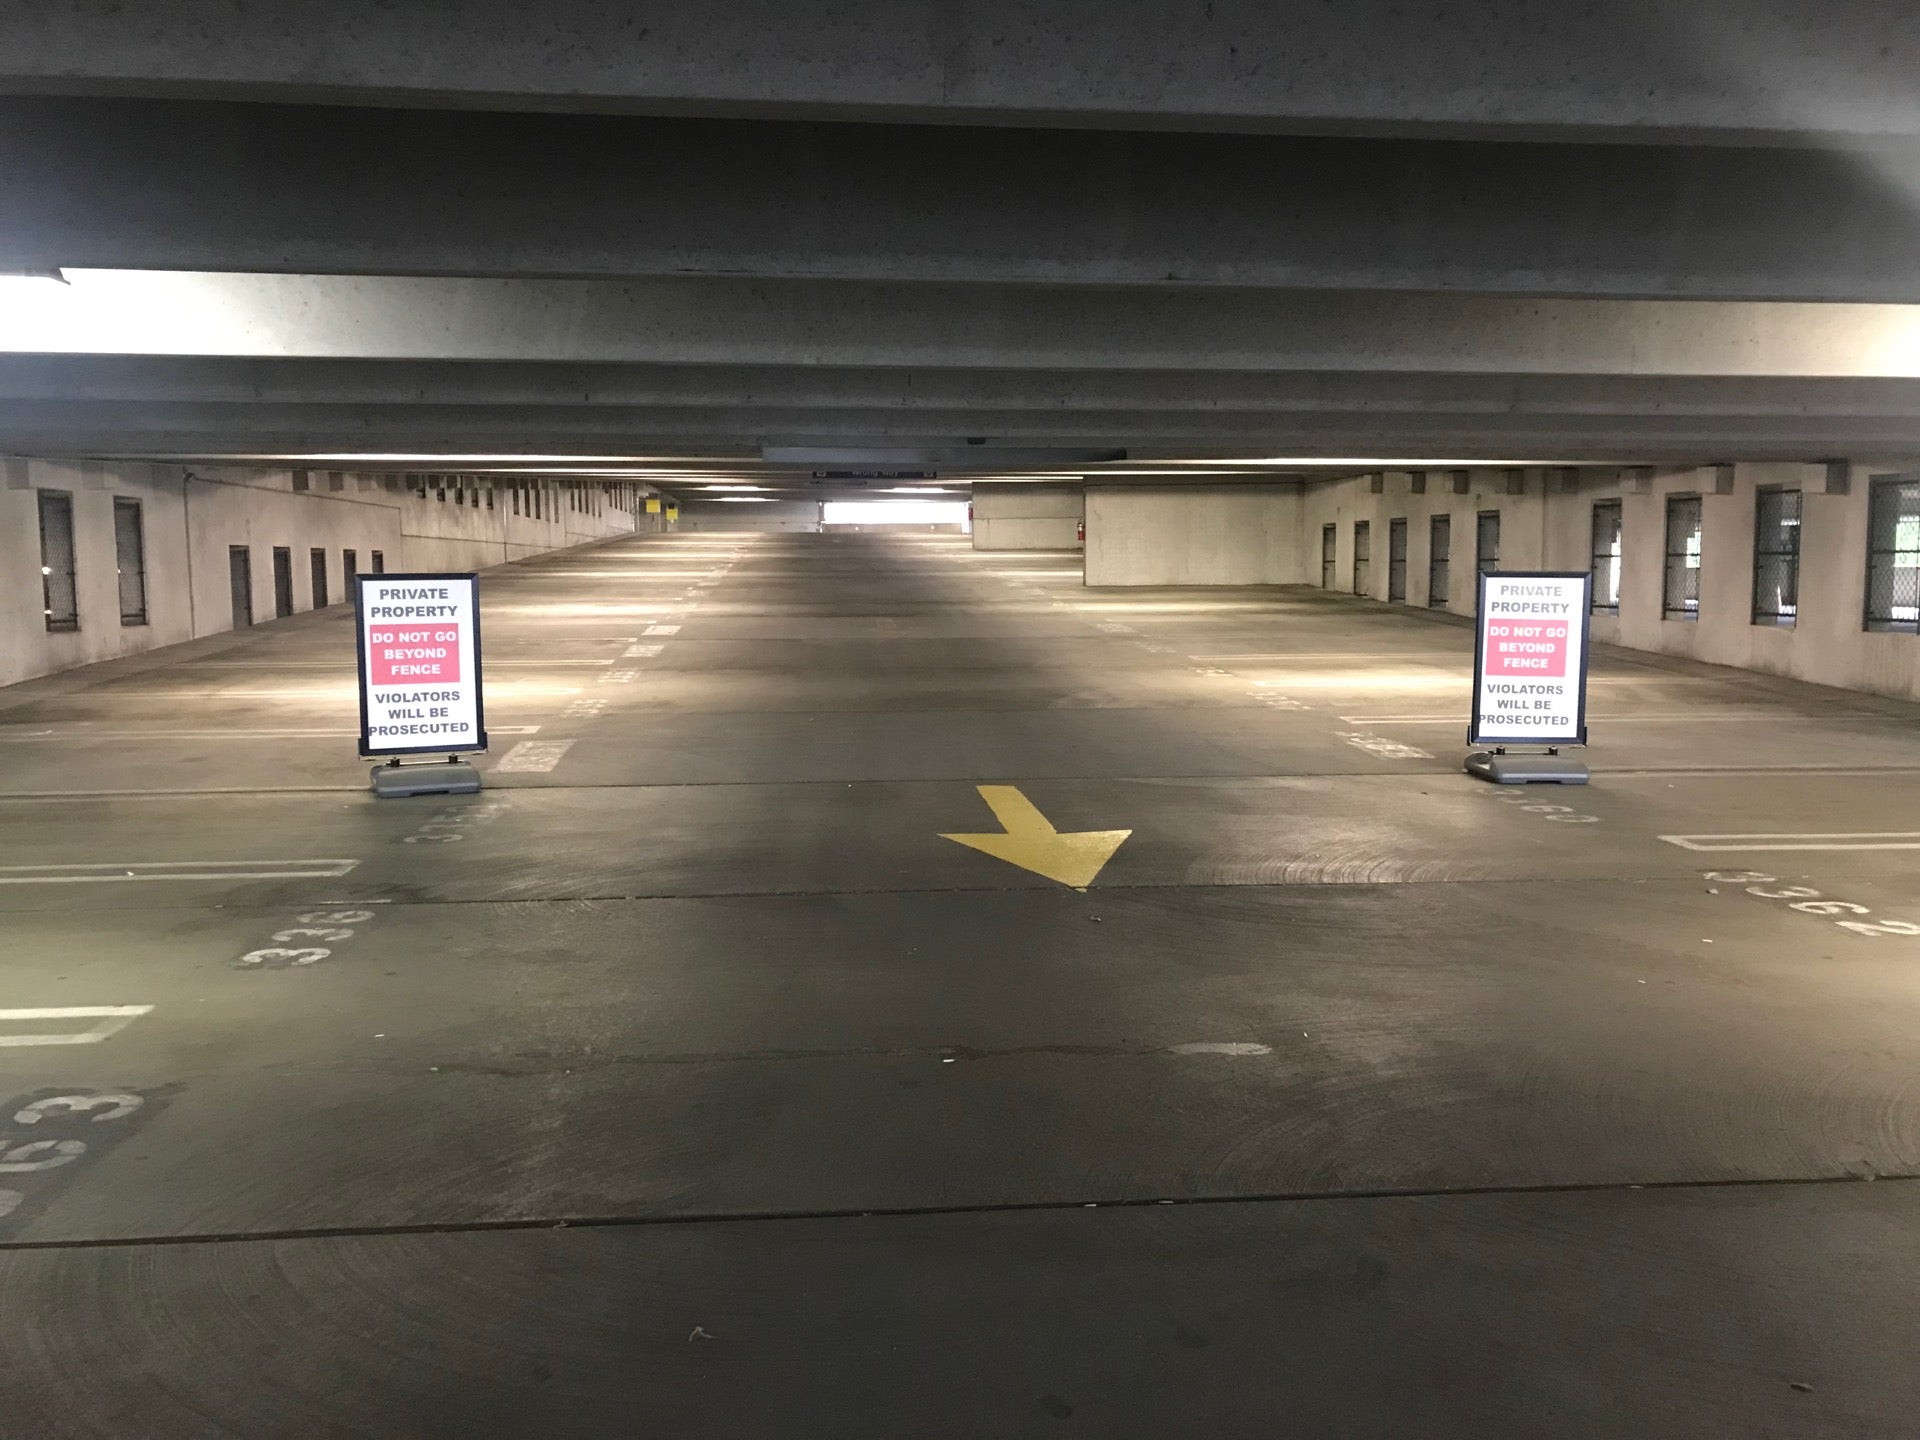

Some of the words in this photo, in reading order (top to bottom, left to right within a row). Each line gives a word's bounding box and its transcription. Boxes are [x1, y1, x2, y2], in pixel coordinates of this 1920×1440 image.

[379, 588, 449, 600] PRIVATE
[1500, 585, 1562, 597] PRIVATE
[371, 605, 458, 618] PROPERTY
[1491, 602, 1570, 614] PROPERTY
[372, 632, 394, 643] DO
[399, 631, 430, 643] NOT
[435, 631, 456, 642] GO
[1490, 626, 1509, 637] DO
[1513, 626, 1542, 638] NOT
[1546, 627, 1566, 638] GO
[384, 648, 446, 660] BEYOND
[1499, 643, 1555, 654] BEYOND
[1504, 658, 1548, 669] FENCE
[391, 664, 441, 676] FENCE
[1487, 684, 1564, 695] VIOLATORS
[375, 690, 460, 704] VIOLATORS
[1497, 700, 1529, 710] WILL
[1534, 700, 1552, 710] BE
[388, 708, 424, 720] WILL
[429, 707, 449, 718] BE
[1479, 714, 1569, 726] PROSECUTED
[369, 722, 469, 736] PROSECUTED
[1703, 871, 1920, 937] 3362
